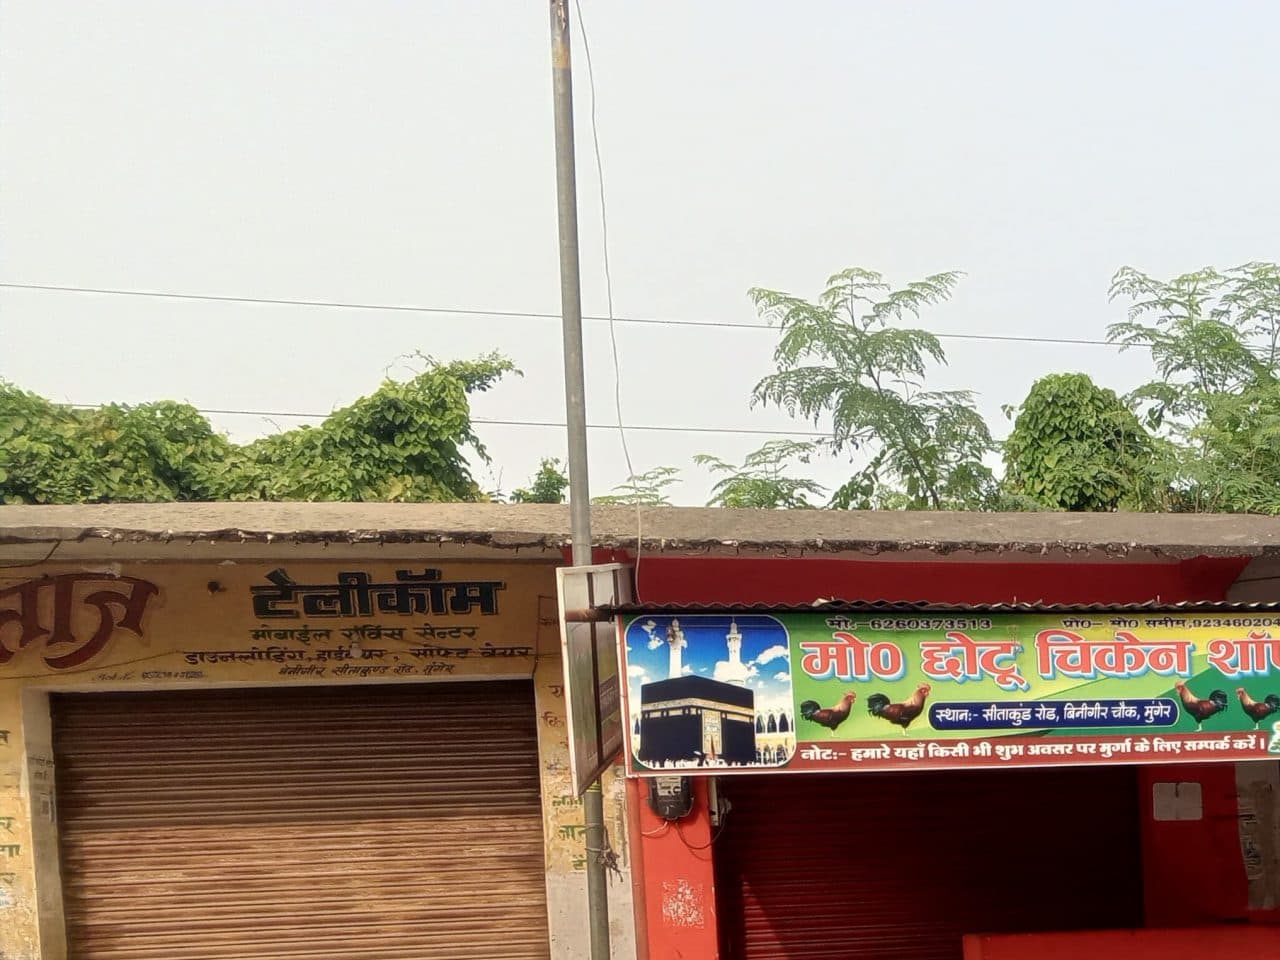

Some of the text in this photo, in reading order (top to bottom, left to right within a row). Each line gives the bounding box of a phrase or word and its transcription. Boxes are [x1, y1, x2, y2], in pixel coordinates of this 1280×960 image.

[250, 568, 507, 619] टेलीकॉम
[920, 631, 1030, 691] छोटू
[1036, 629, 1196, 678] चिकेन
[982, 703, 1031, 725] सीताकुंड
[1035, 703, 1059, 722] रोड,
[1064, 702, 1108, 720] बिनीगीर
[1111, 701, 1140, 721] चौक,
[1144, 700, 1172, 723] मुंगेर
[851, 744, 893, 761] हमारे
[894, 742, 925, 760] यहाँ
[928, 742, 971, 758] किसी
[973, 742, 993, 757] भी
[995, 745, 1024, 760] शुभ
[1028, 742, 1073, 756] अवसर
[1076, 741, 1096, 754] पर
[1099, 738, 1132, 757] मुर्गा
[1135, 738, 1150, 753] के
[1153, 737, 1181, 754] लिए
[1184, 735, 1230, 752] सम्पर्क
[1233, 734, 1256, 751] करें
